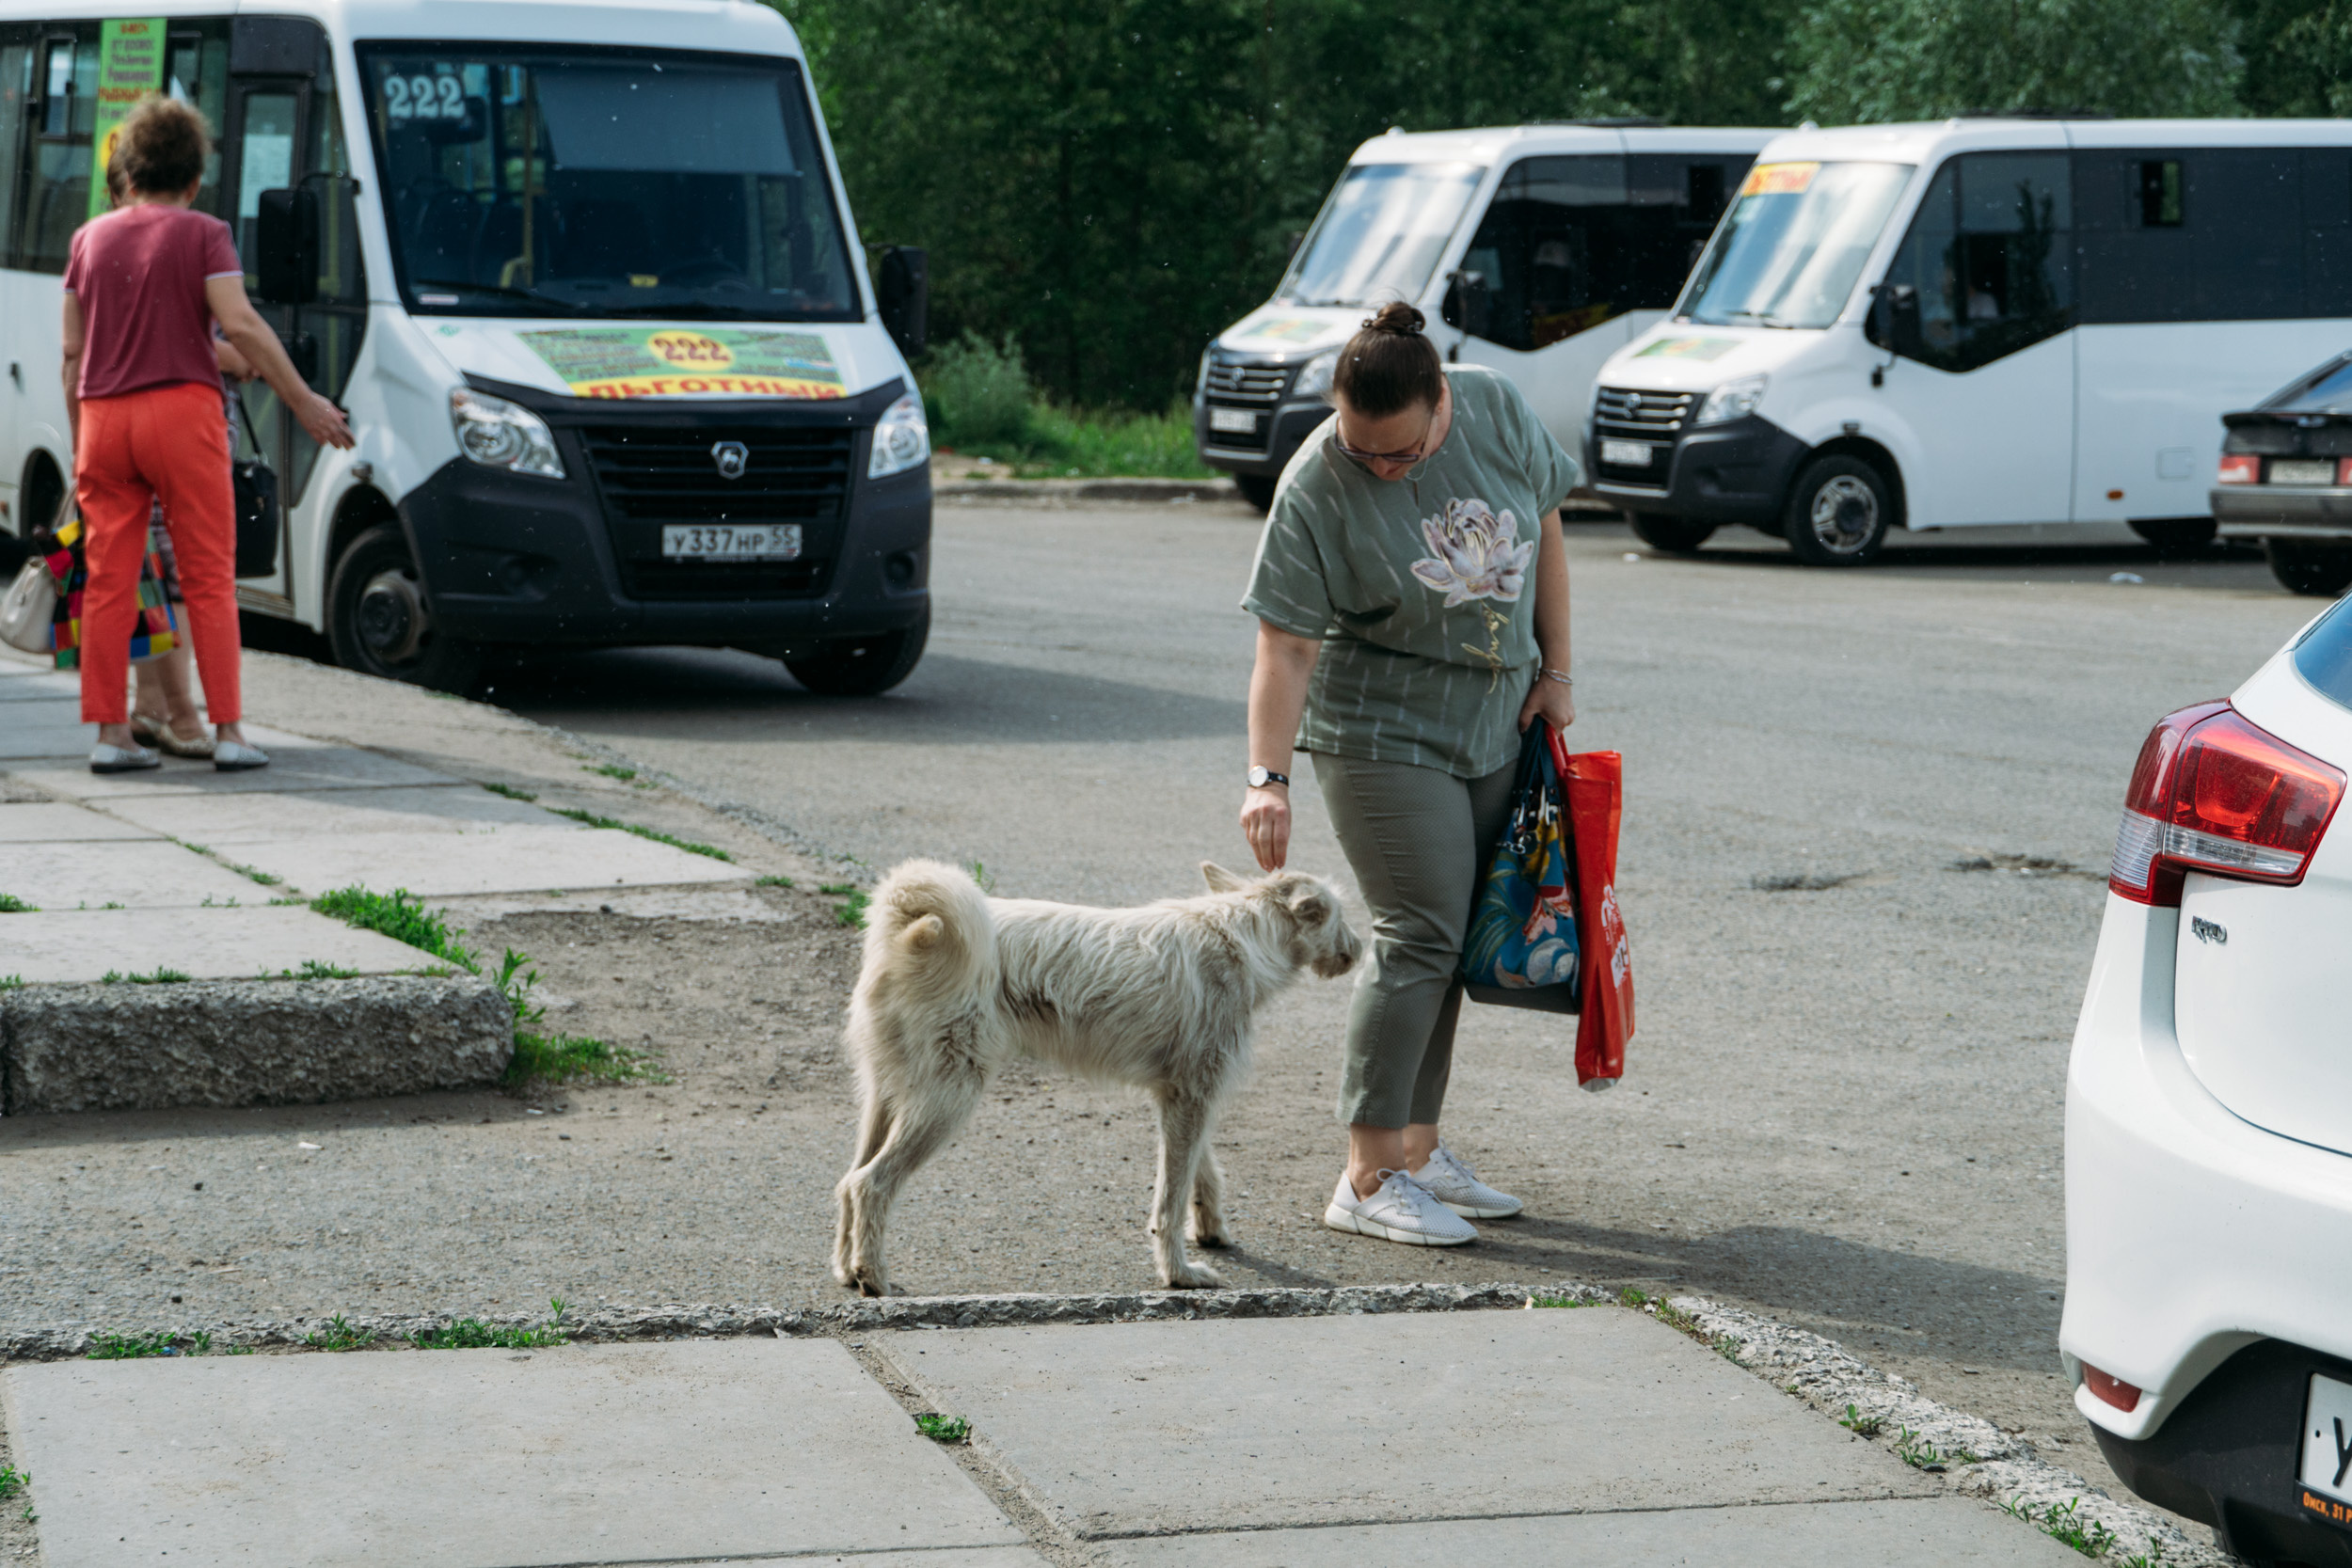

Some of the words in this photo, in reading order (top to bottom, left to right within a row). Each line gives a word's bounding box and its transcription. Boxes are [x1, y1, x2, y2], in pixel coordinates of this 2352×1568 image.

[384, 75, 466, 119] 222
[653, 337, 730, 362] 222
[2332, 1503, 2344, 1521] 31
